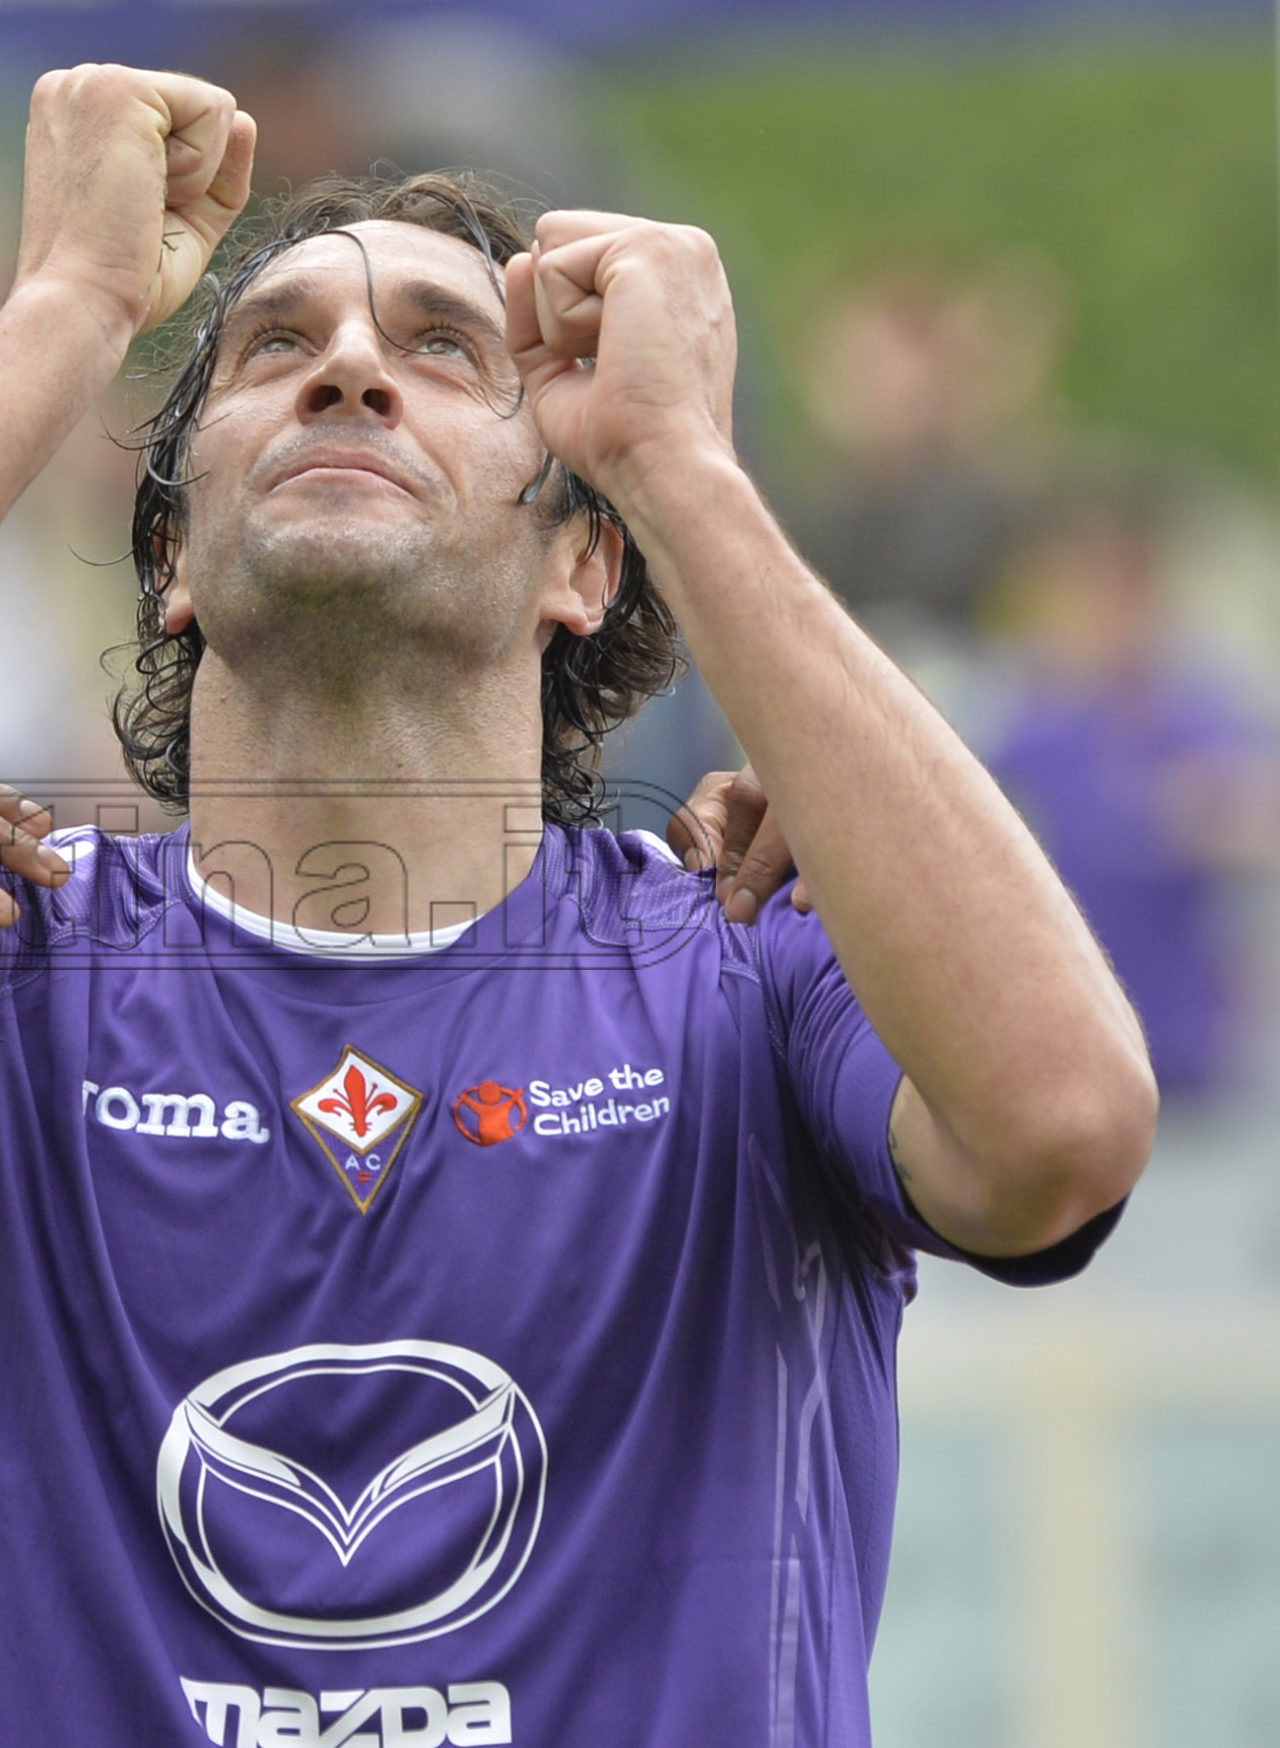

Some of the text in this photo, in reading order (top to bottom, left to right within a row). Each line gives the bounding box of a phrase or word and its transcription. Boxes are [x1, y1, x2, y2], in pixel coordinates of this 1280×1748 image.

[529, 1064, 664, 1107] Save the
[533, 1096, 670, 1135] Children
